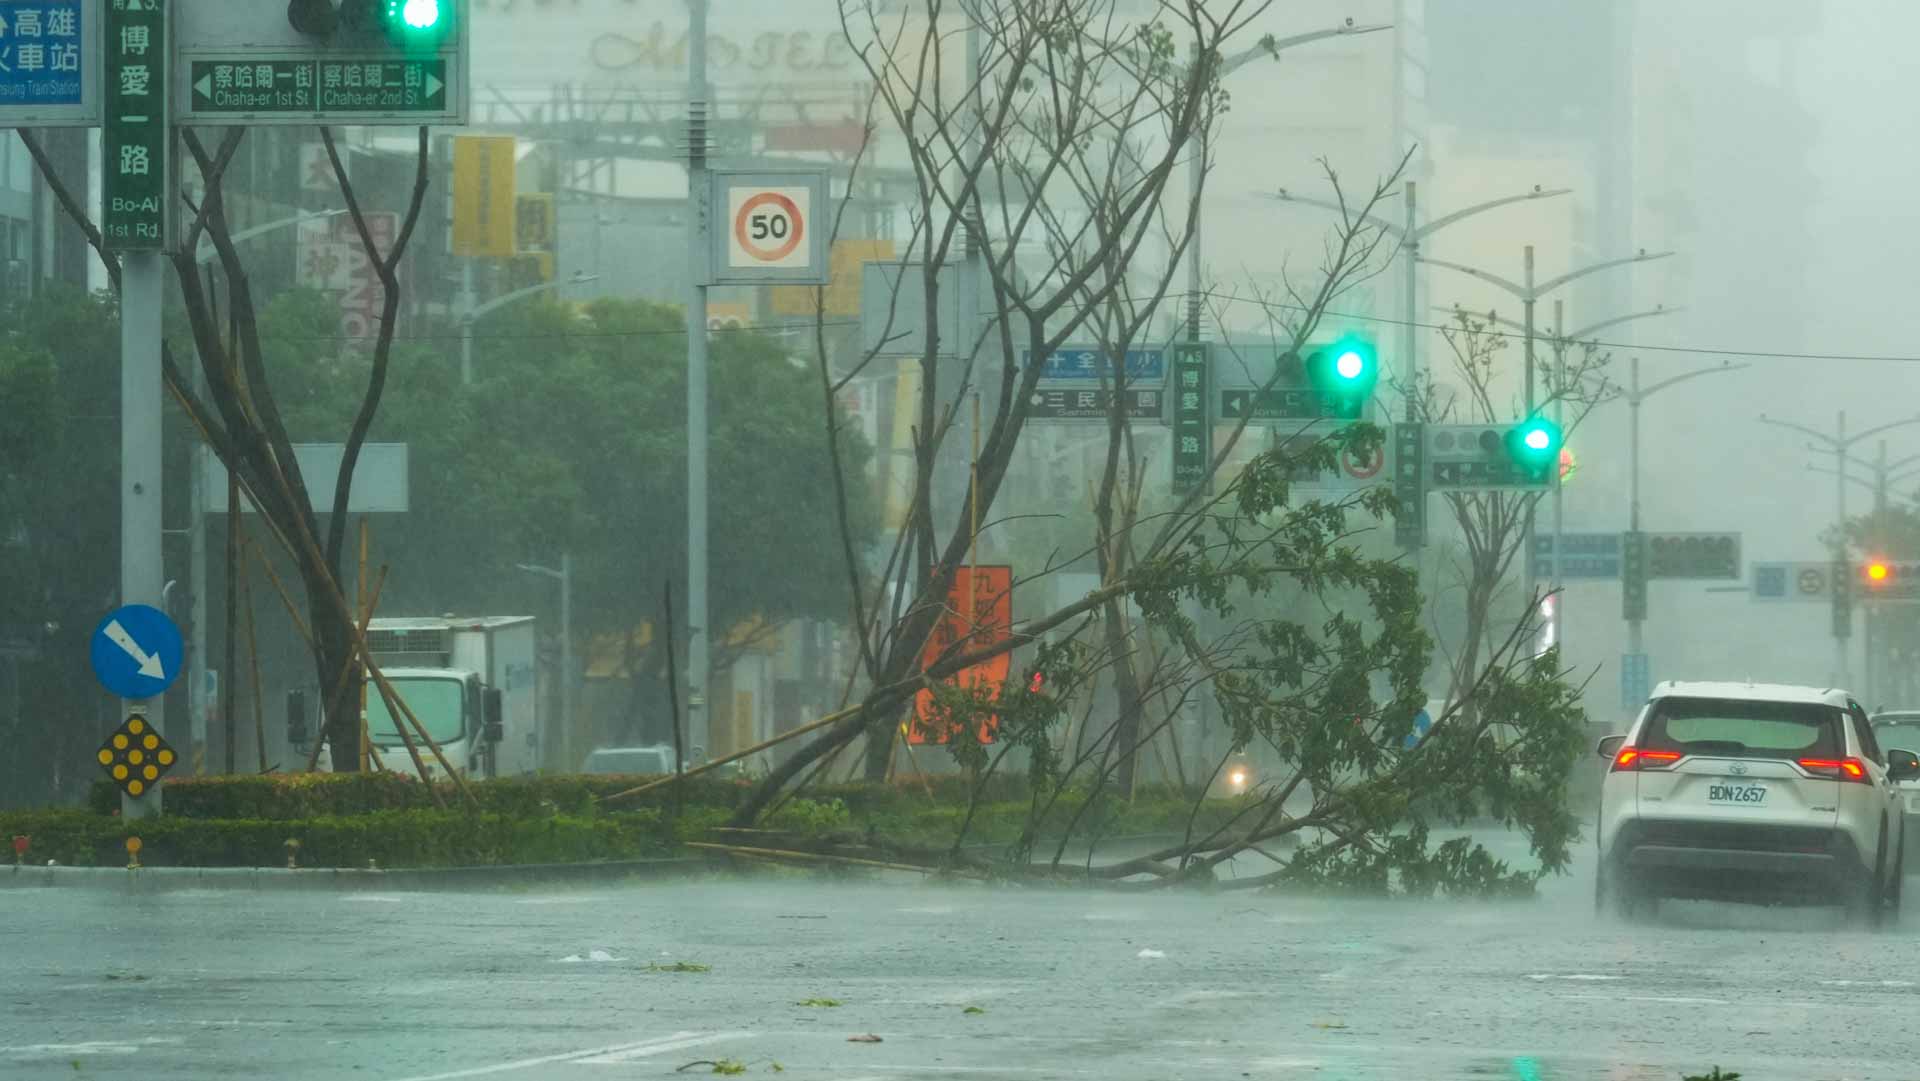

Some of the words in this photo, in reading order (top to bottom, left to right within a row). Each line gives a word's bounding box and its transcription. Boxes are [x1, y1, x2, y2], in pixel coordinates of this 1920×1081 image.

[14, 8, 77, 37] 高雄
[214, 64, 313, 89] 察哈爾一街
[323, 64, 422, 89] 察哈爾二街
[120, 25, 150, 175] 博愛一路
[214, 90, 271, 106] Chaha-er
[275, 90, 292, 105] 1st
[324, 90, 378, 106] Chaha-er
[380, 90, 401, 105] 2nd
[112, 195, 159, 213] Bo-Ai
[751, 214, 788, 240] 50
[1046, 351, 1158, 370] 十全小
